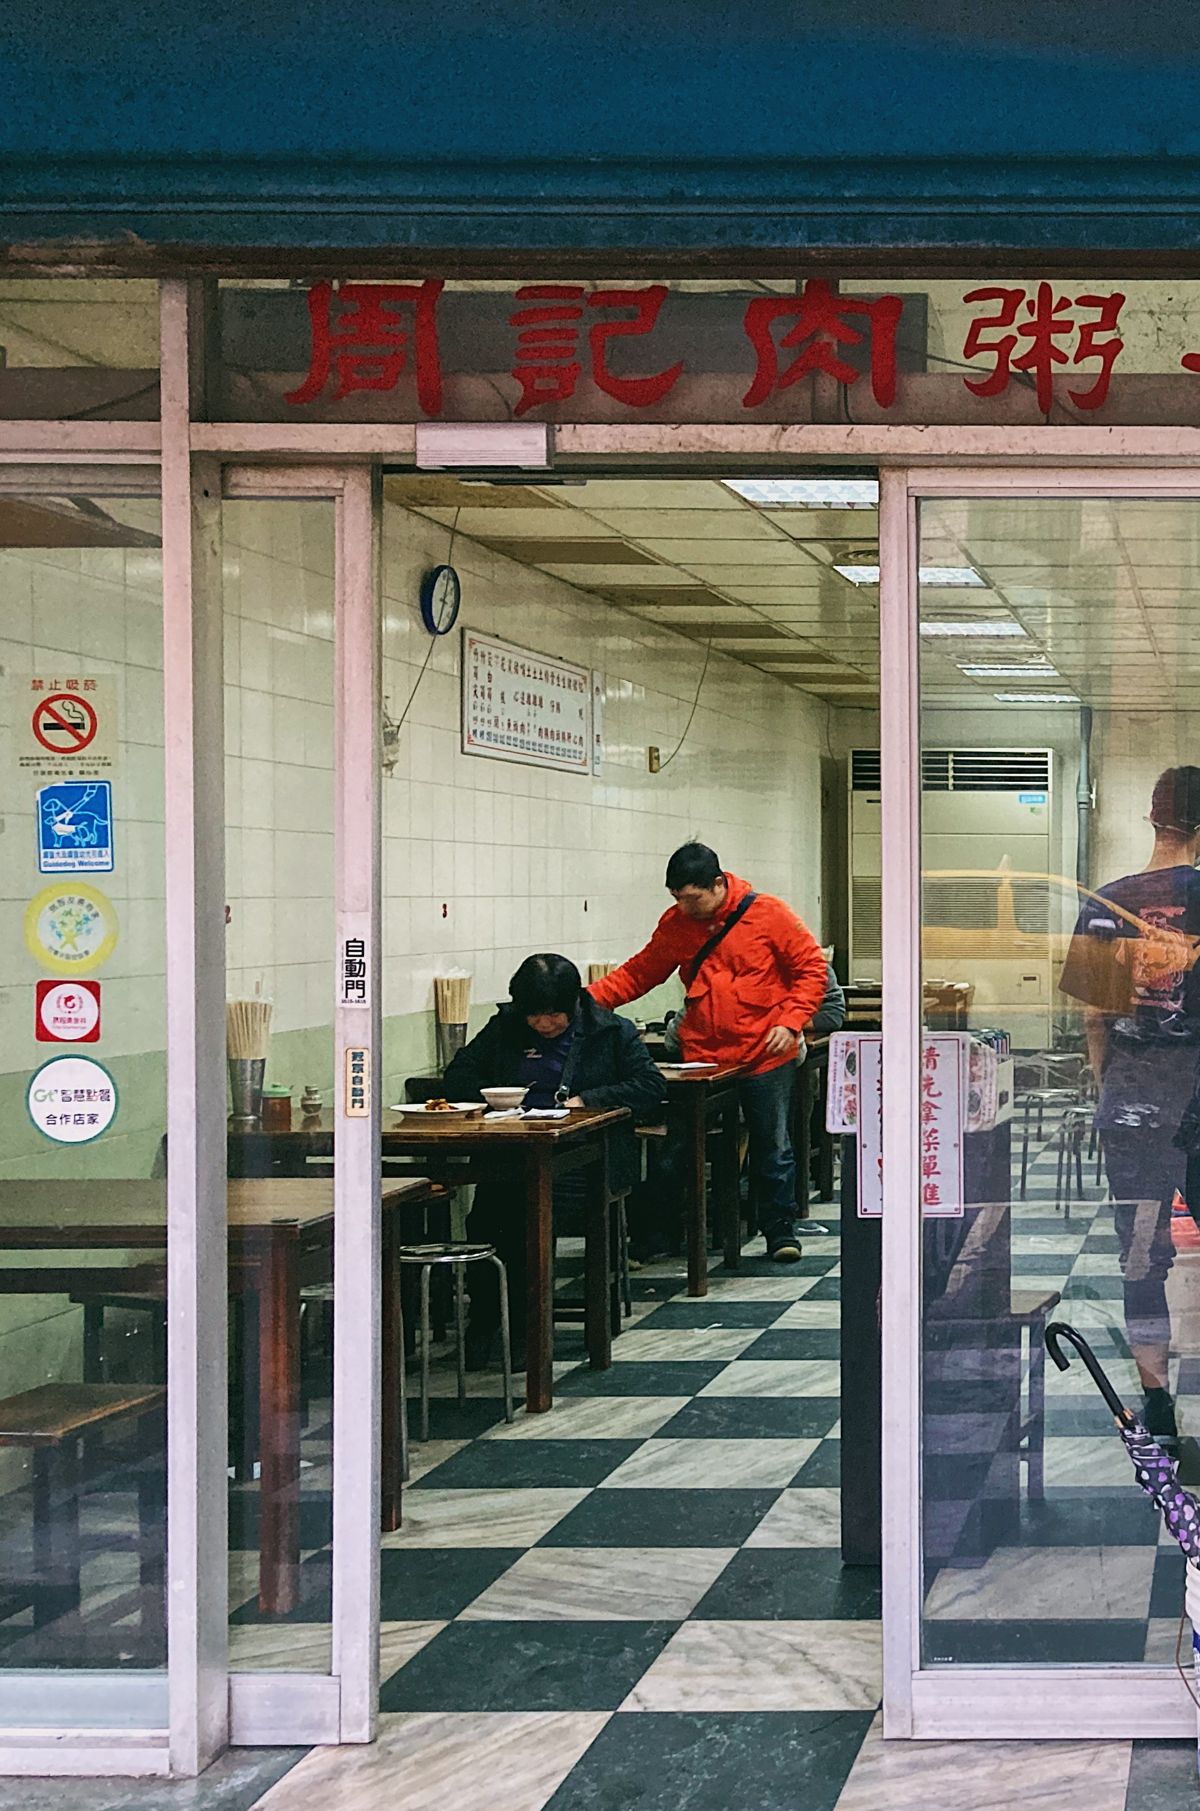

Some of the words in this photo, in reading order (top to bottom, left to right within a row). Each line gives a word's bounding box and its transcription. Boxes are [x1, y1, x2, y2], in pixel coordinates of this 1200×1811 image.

[31, 679, 97, 691] 禁止吸菸
[345, 938, 366, 999] 自動門
[45, 1113, 100, 1126] 合作店家
